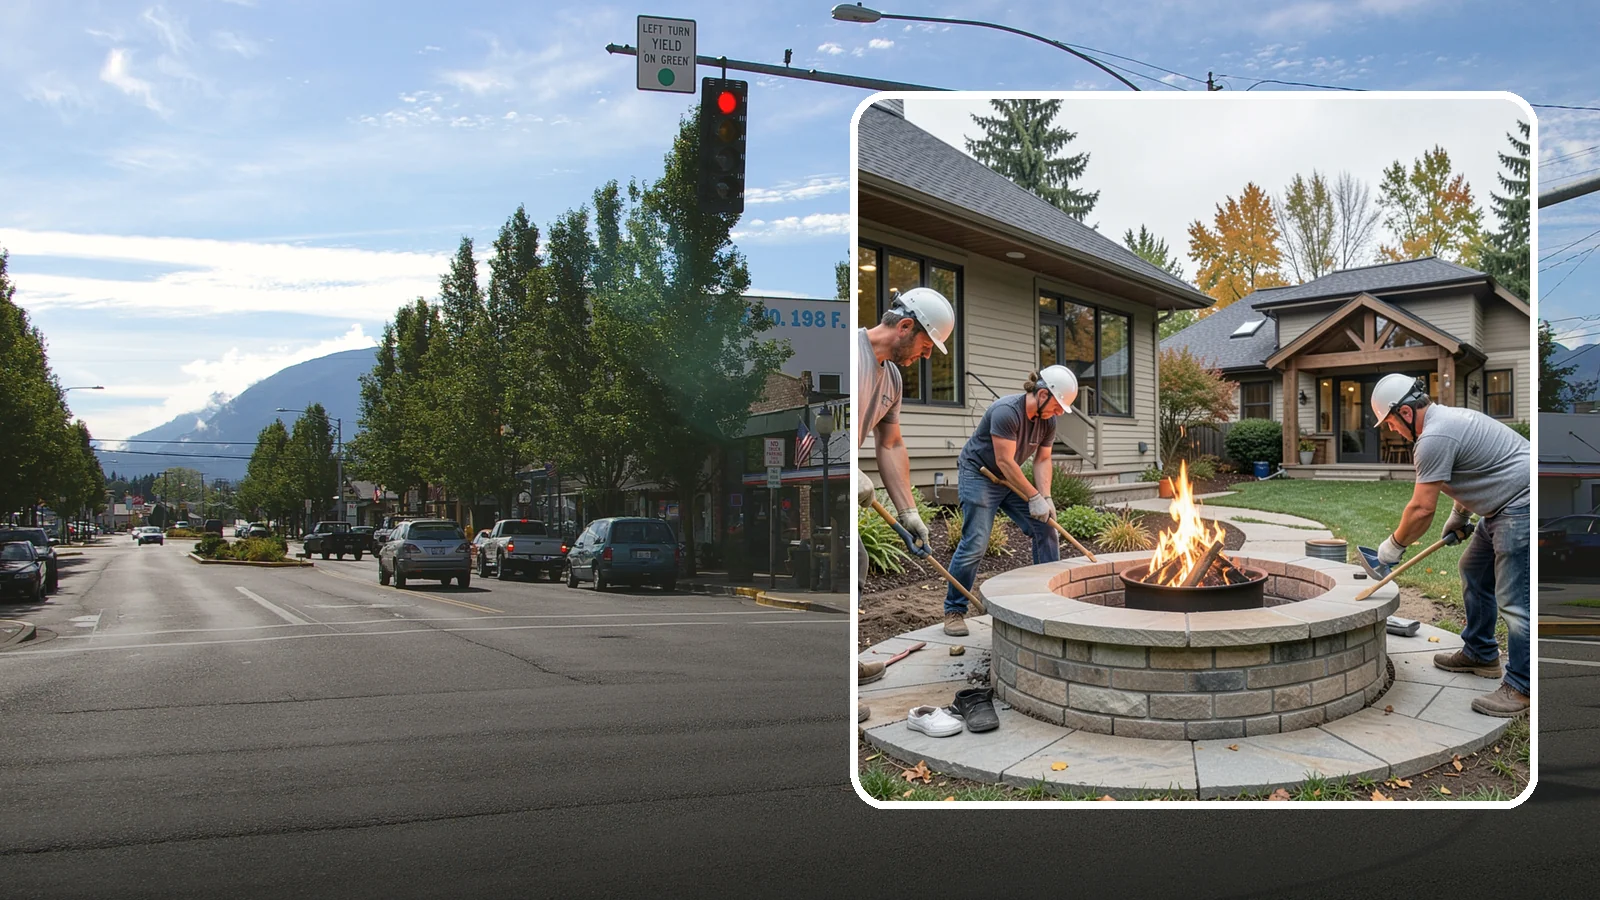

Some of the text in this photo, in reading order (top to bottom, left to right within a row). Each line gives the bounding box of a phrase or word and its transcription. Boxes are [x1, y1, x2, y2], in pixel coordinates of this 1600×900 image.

[643, 24, 690, 36] LEFT TURN
[652, 38, 682, 51] YIELD
[791, 309, 826, 328] 198
[831, 311, 847, 329] F.
